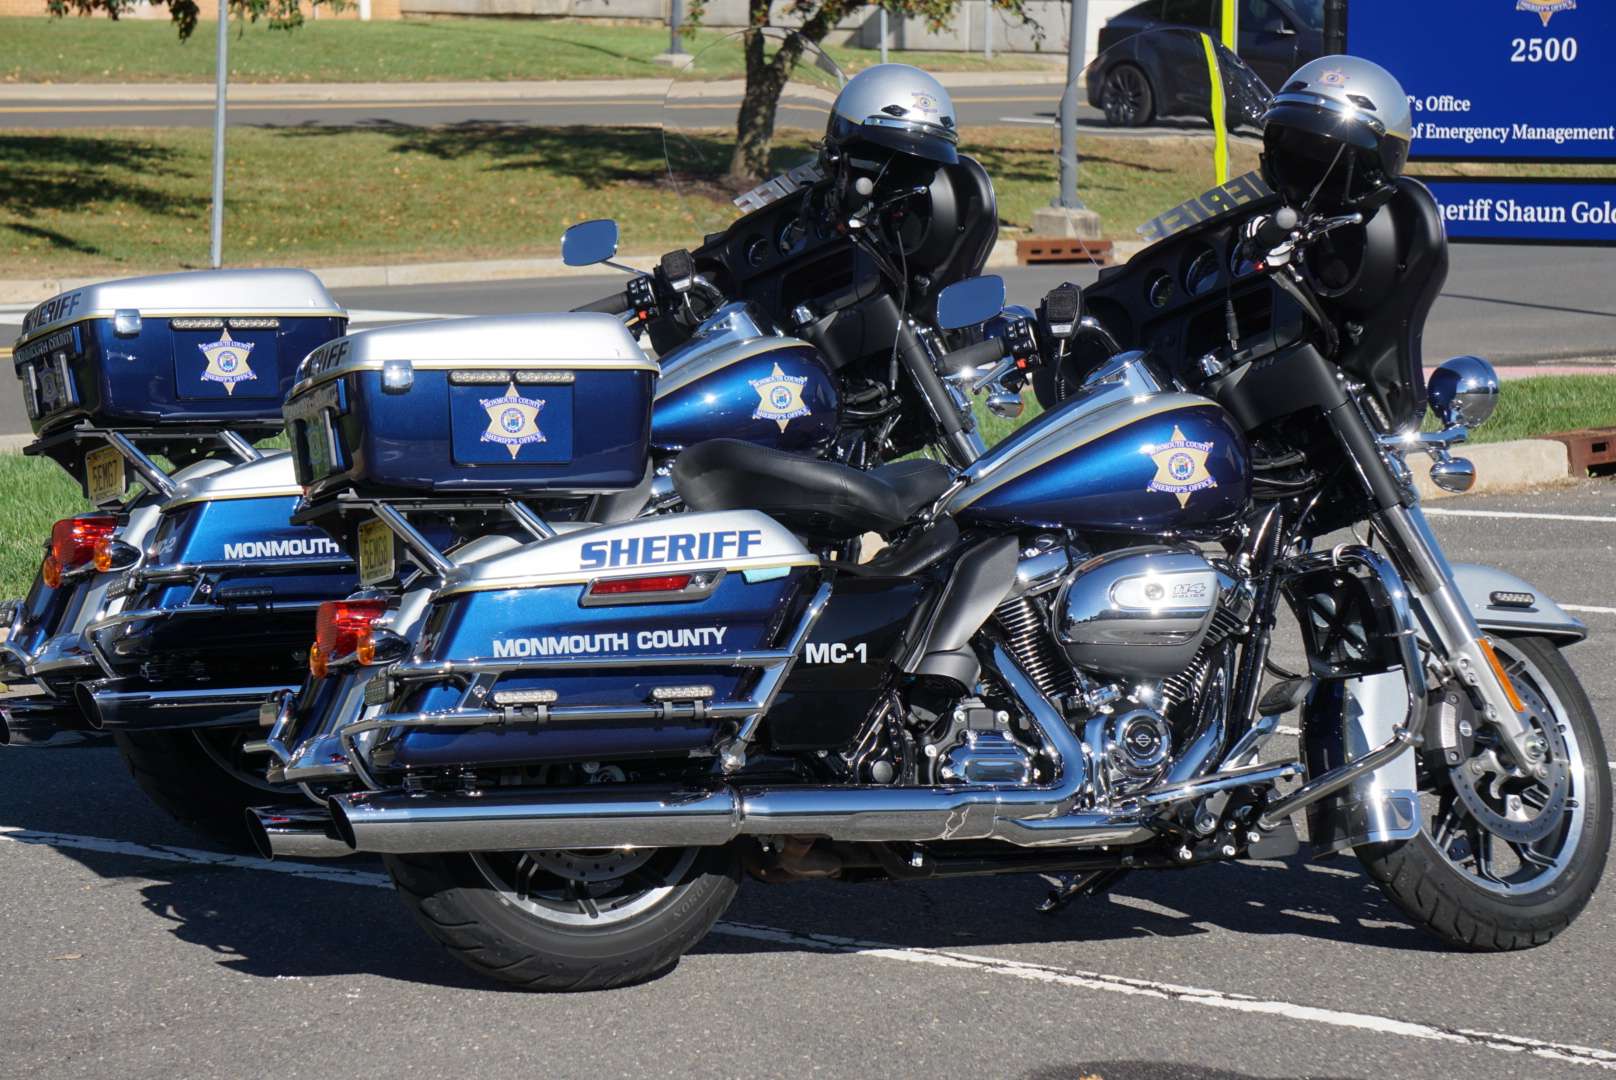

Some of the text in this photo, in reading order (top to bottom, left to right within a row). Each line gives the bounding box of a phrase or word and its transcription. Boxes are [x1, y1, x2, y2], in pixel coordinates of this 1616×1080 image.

[1511, 37, 1577, 62] 2500
[1425, 95, 1471, 112] Office
[1426, 123, 1509, 143] Emergency
[1512, 124, 1614, 144] Management
[1434, 198, 1493, 221] heriff
[1495, 199, 1566, 223] Shaun
[1185, 440, 1210, 451] COUNTY
[1188, 478, 1213, 492] OFFICE
[223, 537, 340, 560] MONMOUTH
[579, 529, 762, 570] SHERIFF
[492, 626, 728, 658] MONMOUTH COUNTY
[805, 643, 867, 664] MC-1
